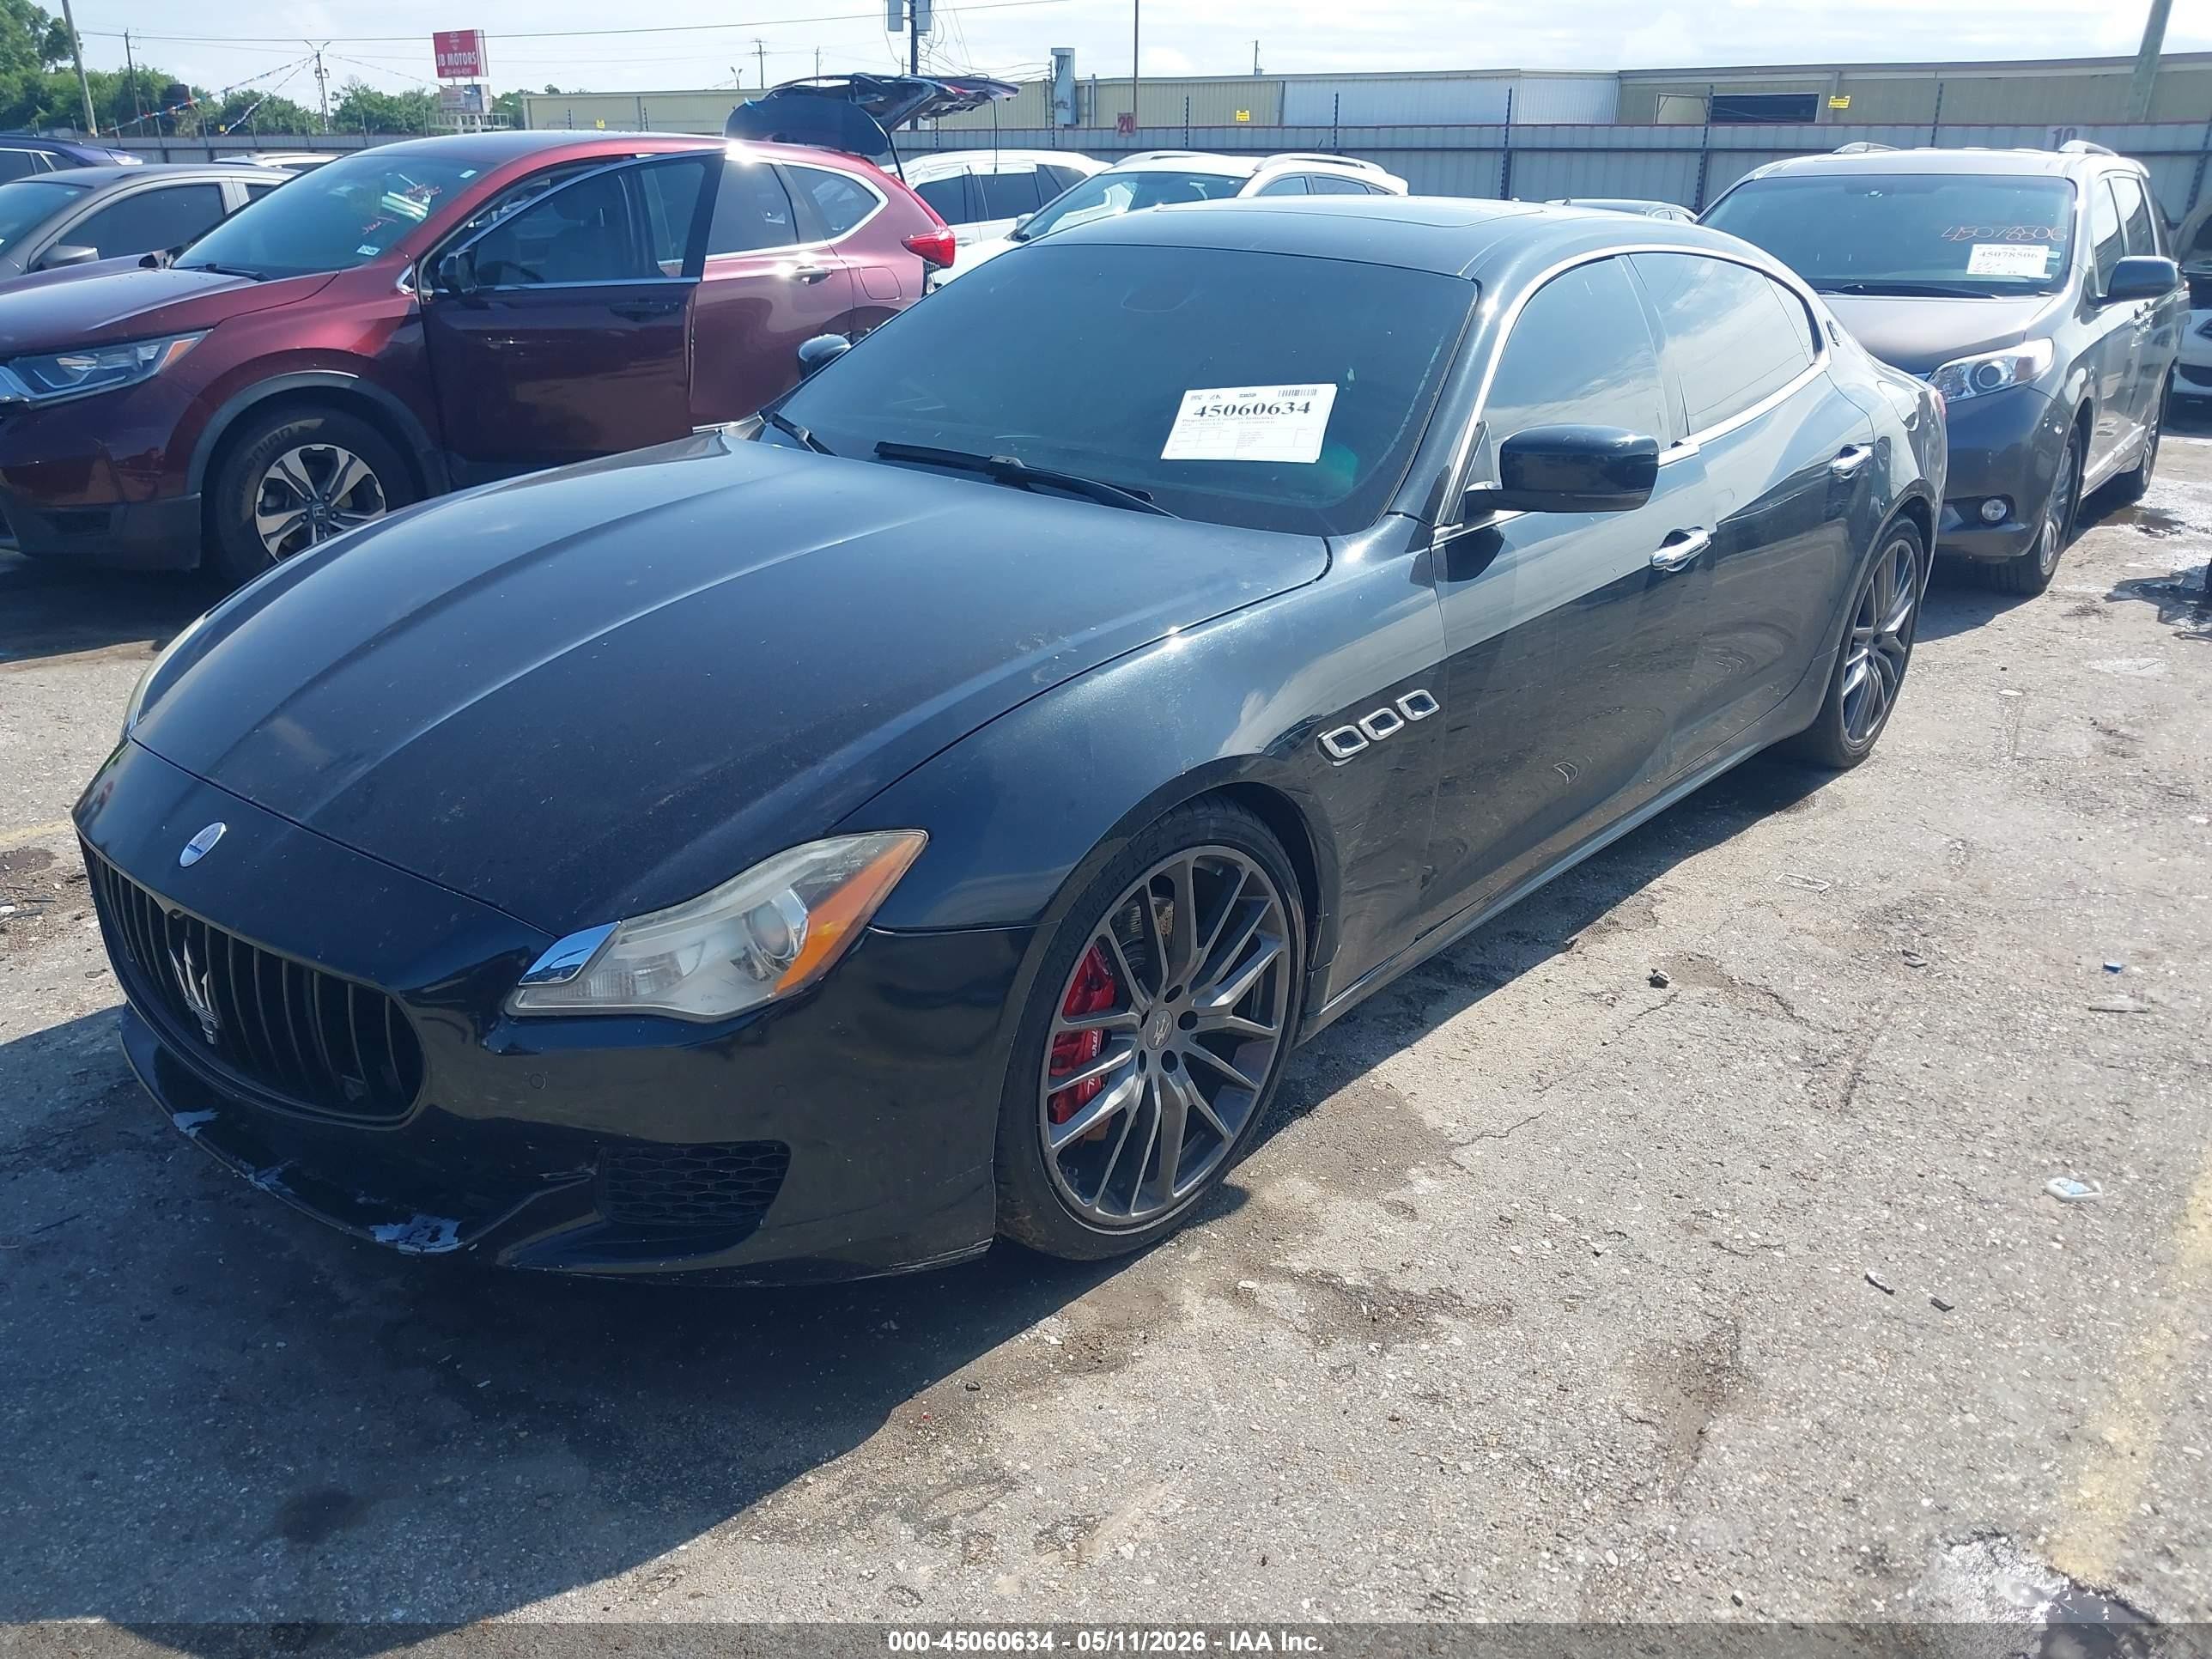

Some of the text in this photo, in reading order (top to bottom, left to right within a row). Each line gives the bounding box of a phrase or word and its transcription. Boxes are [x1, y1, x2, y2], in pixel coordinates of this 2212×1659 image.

[447, 52, 477, 66] MOTORS
[1117, 116, 1134, 133] 20
[1193, 401, 1310, 417] 45060634
